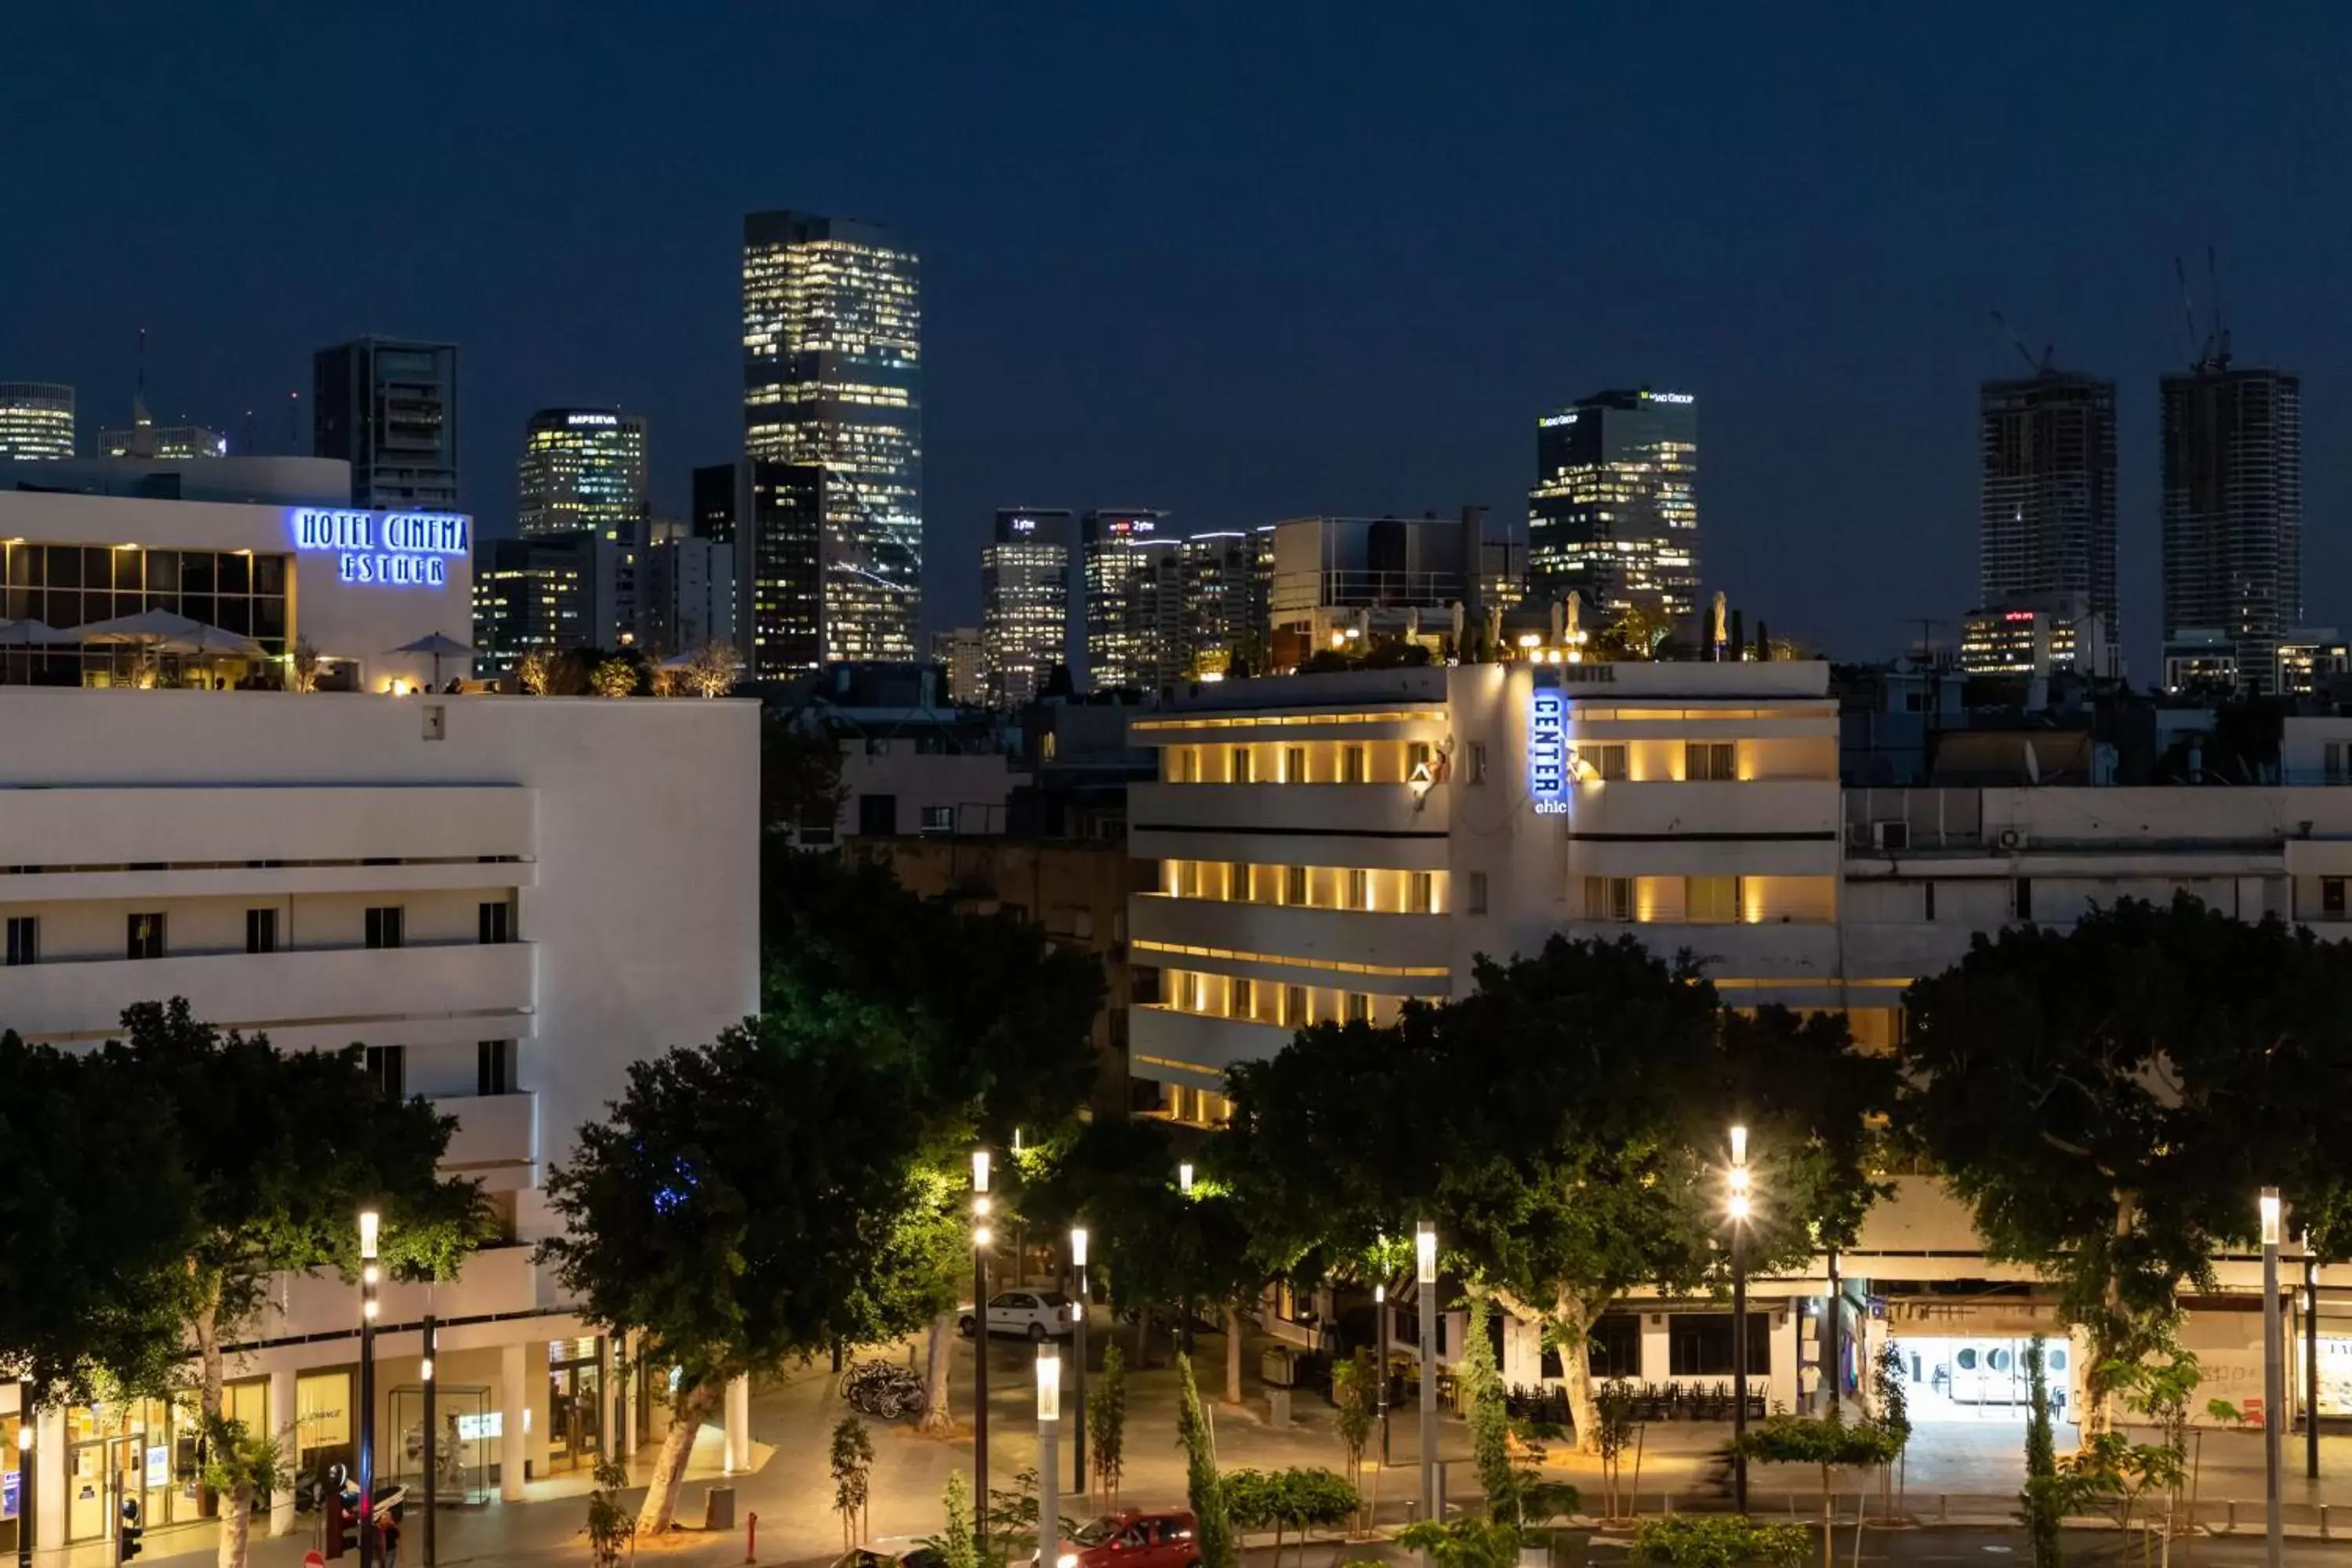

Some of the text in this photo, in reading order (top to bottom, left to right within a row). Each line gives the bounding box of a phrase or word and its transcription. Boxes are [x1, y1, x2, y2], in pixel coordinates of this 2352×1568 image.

[303, 514, 469, 551] HOTEL CINEMA
[344, 555, 443, 582] ESTHER
[1535, 700, 1559, 792] CENTER
[1534, 799, 1567, 814] chic
